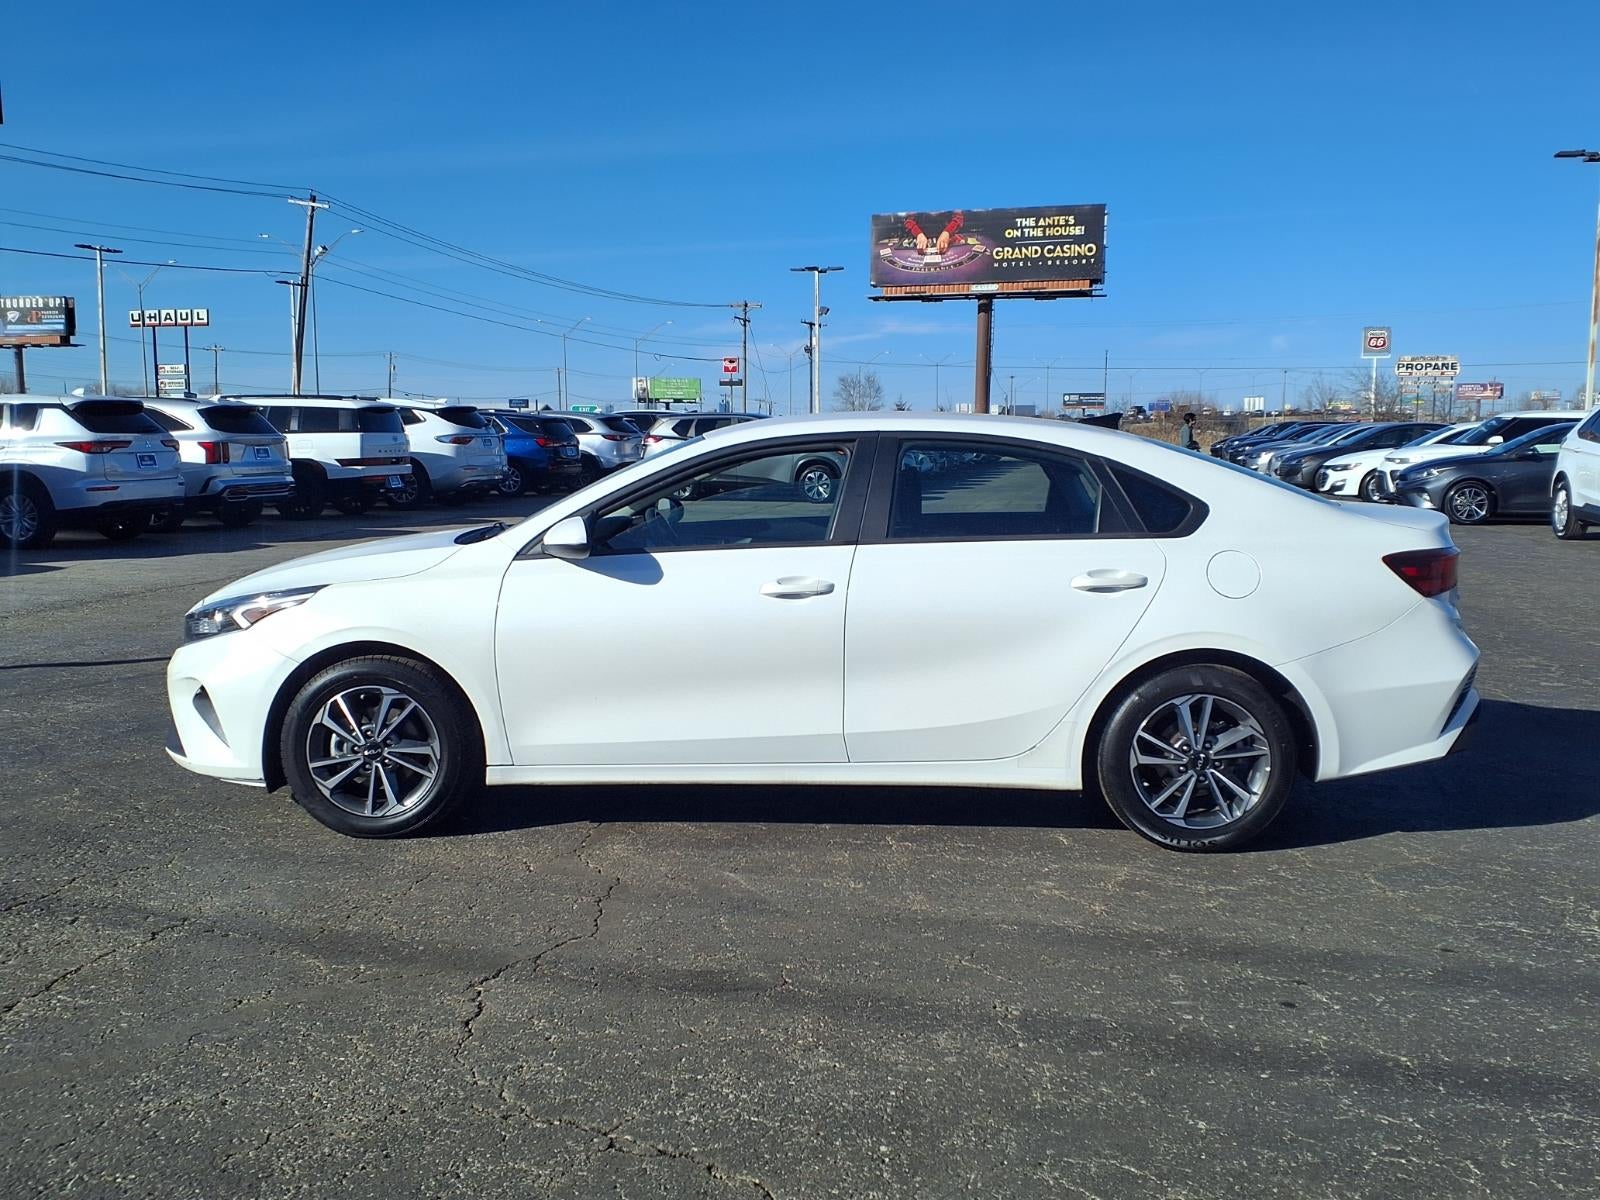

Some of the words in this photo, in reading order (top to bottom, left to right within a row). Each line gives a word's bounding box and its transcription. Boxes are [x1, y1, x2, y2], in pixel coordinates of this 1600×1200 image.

[1015, 217, 1036, 227] THE
[1038, 215, 1075, 226] ANTE'S
[1004, 228, 1021, 238] ON
[1023, 227, 1044, 237] THE
[1046, 226, 1085, 236] HOUSE!
[992, 245, 1041, 260] GRAND
[1043, 243, 1097, 257] CASINO
[0, 297, 43, 308] THUNDER
[49, 297, 65, 307] UP!
[1369, 337, 1385, 347] 66
[1397, 362, 1458, 371] PROPANE
